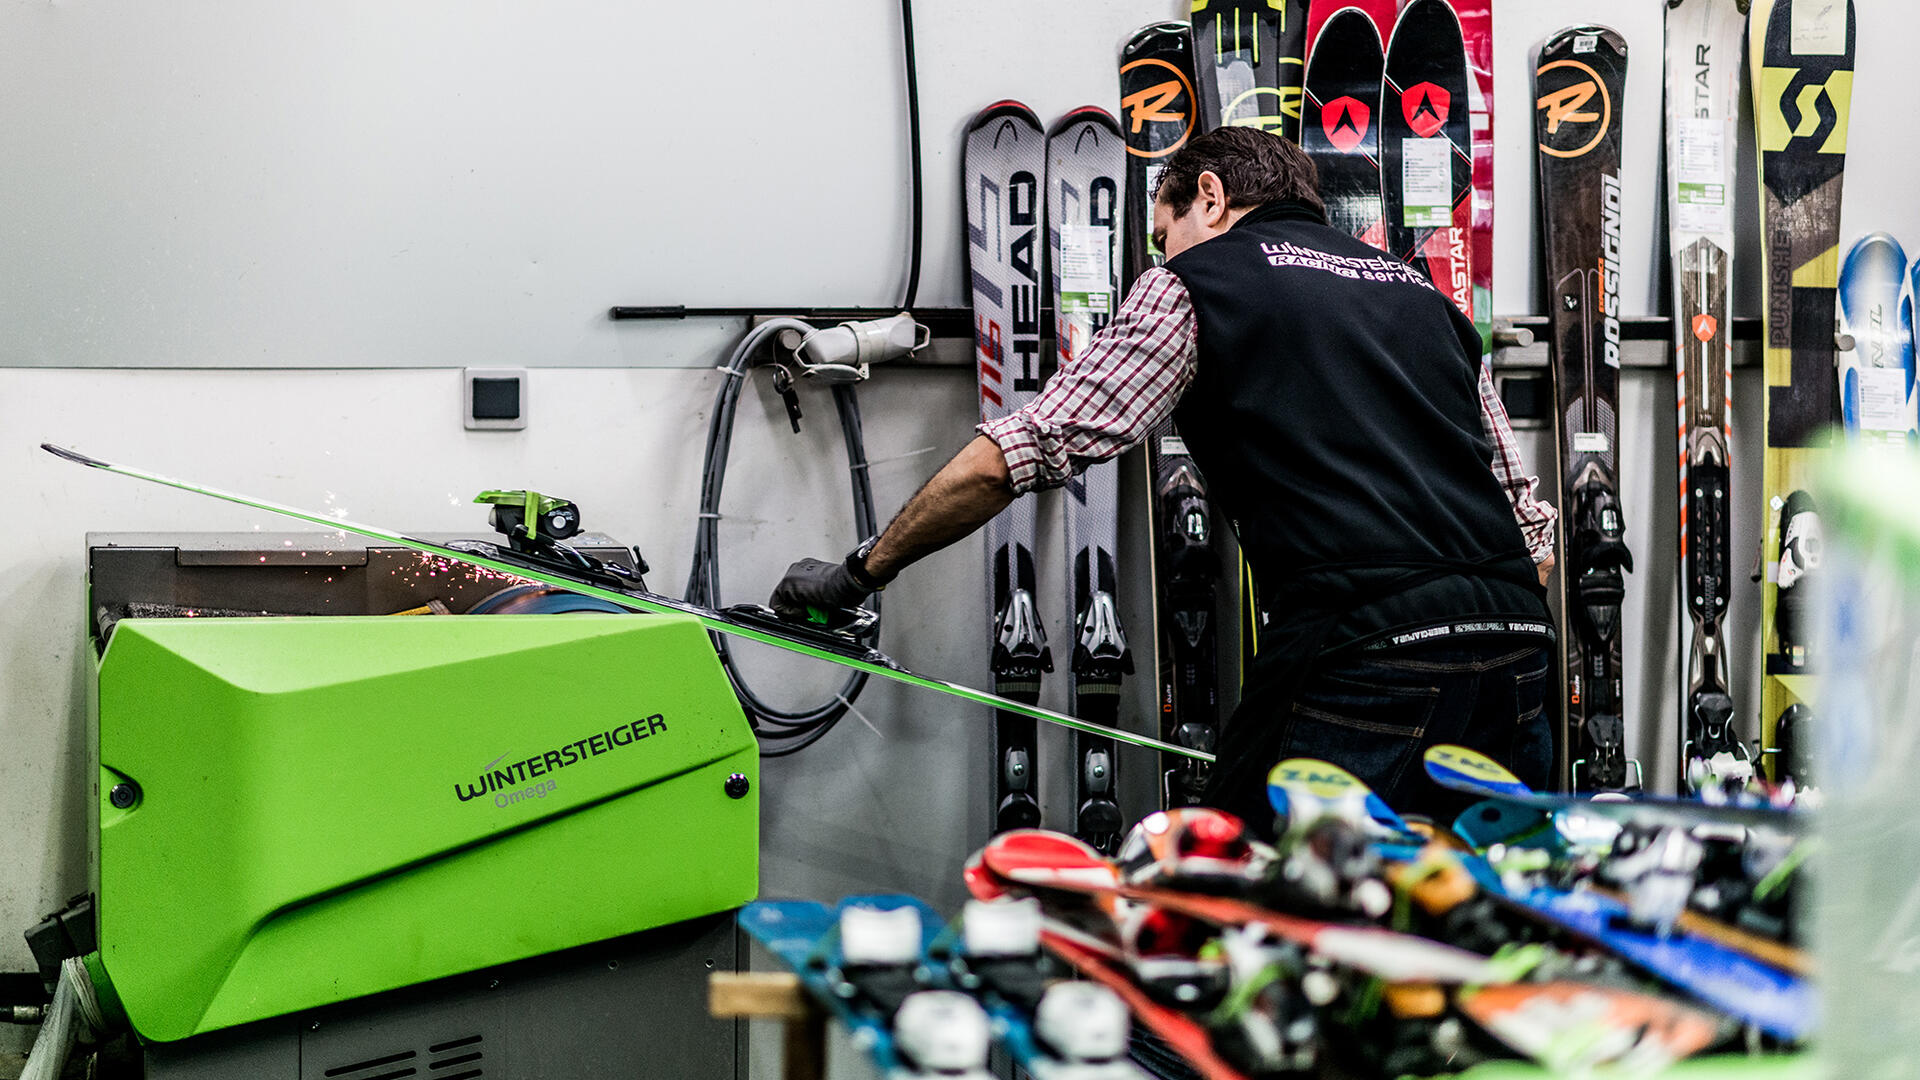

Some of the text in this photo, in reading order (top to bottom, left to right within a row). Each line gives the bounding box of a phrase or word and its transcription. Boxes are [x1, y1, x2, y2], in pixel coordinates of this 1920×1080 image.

[1009, 170, 1040, 392] HEAD
[1267, 254, 1360, 279] RACING
[1603, 167, 1621, 369] ROSSIGNOL
[1768, 222, 1792, 348] PUNISHE
[454, 713, 668, 802] WINTERSTEIGER
[494, 778, 557, 808] Omega
